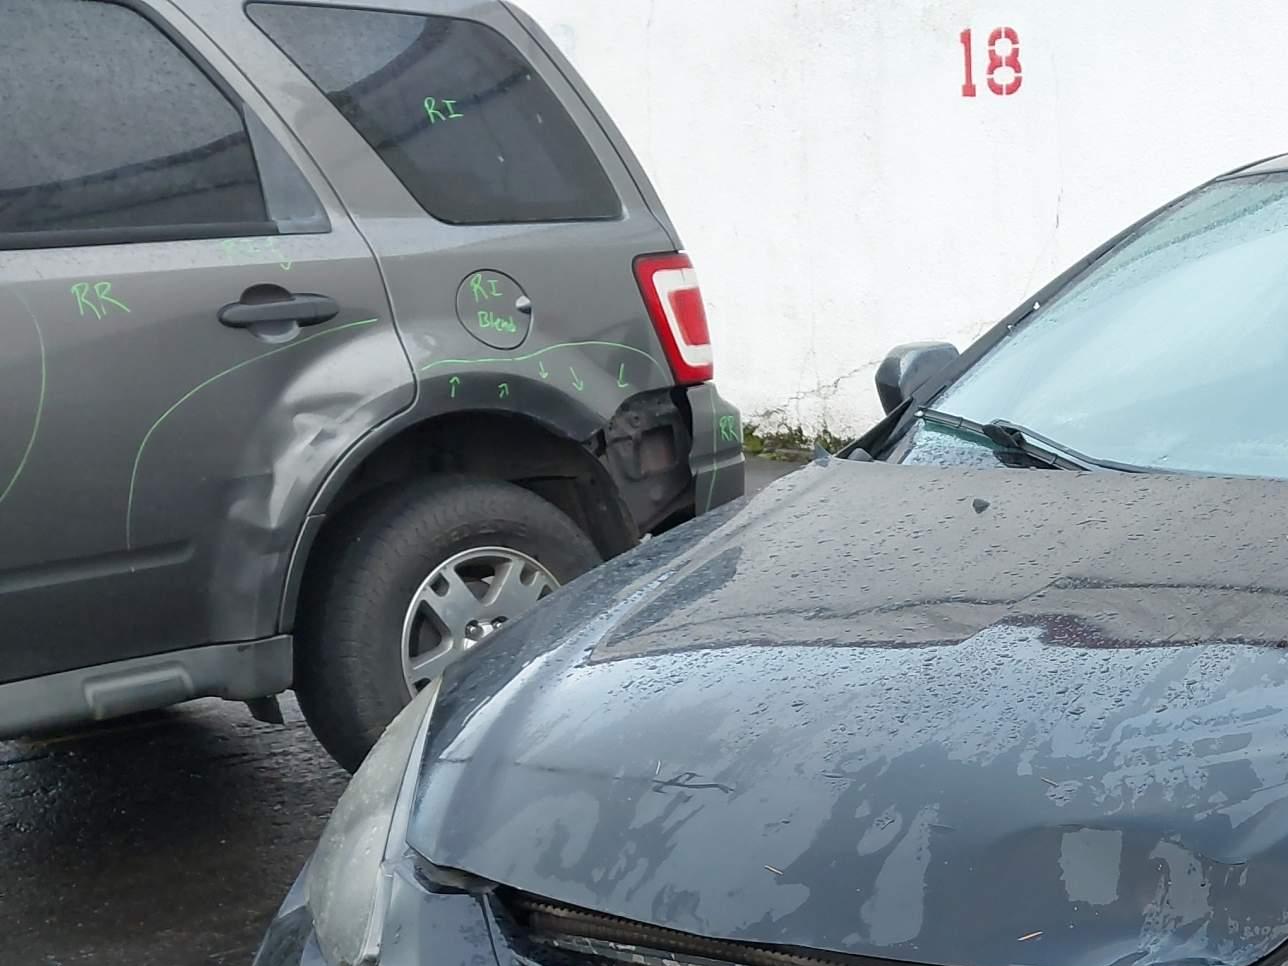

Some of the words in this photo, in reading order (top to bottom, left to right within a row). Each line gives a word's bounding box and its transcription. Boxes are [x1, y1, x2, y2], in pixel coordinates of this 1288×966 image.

[960, 27, 1022, 97] 18
[424, 96, 464, 124] RI
[71, 281, 130, 320] RR
